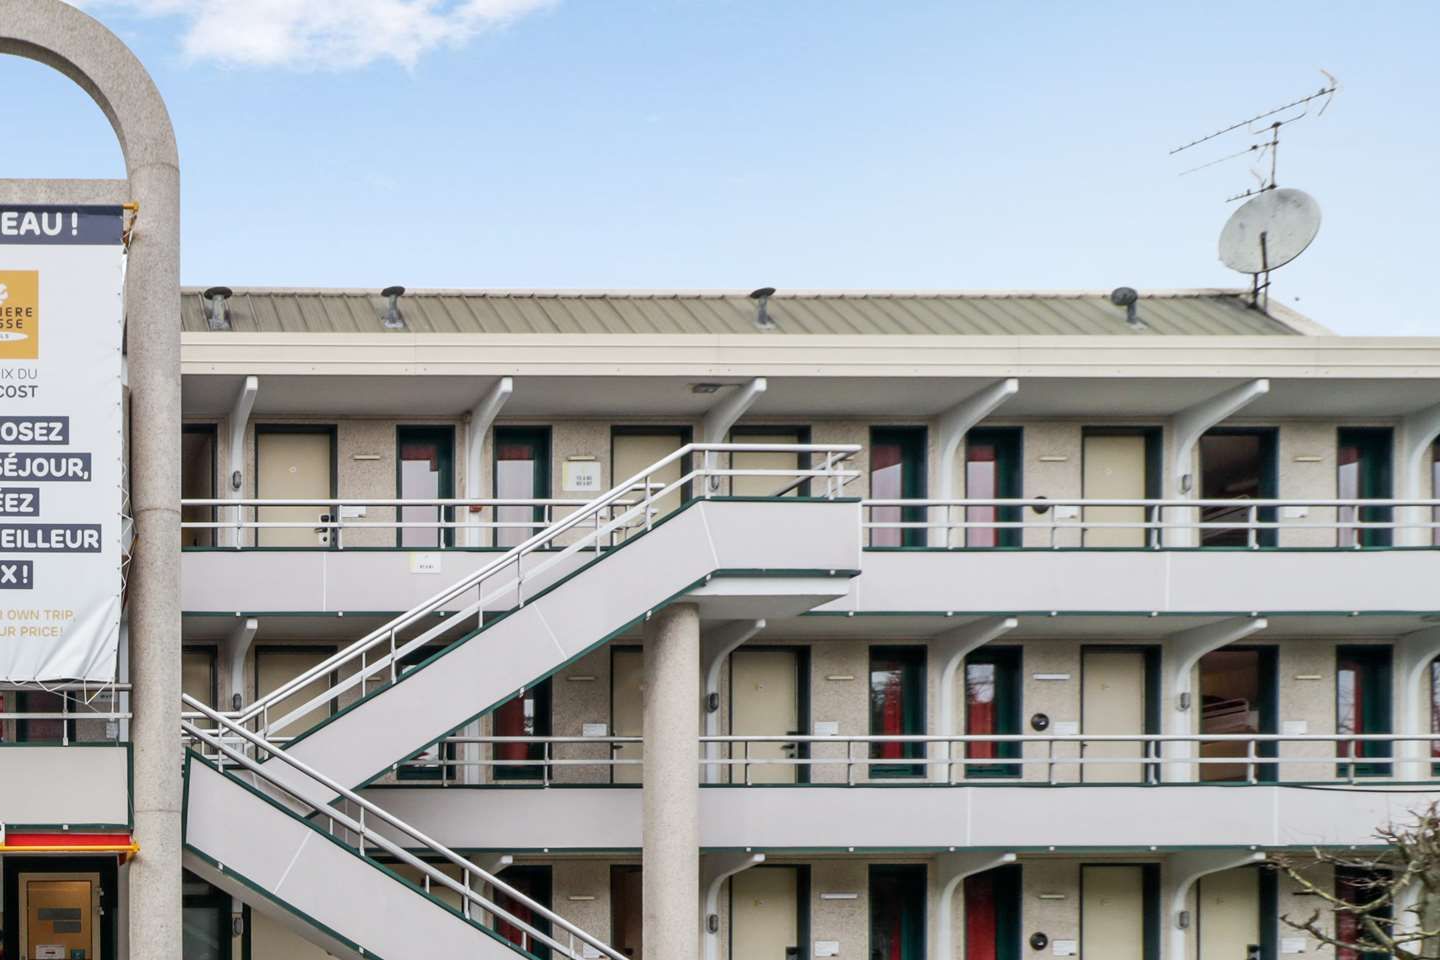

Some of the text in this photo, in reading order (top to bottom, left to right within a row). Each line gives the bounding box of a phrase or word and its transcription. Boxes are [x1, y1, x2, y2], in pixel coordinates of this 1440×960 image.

[17, 368, 38, 380] DU
[7, 609, 40, 620] OWN
[44, 609, 77, 622] TRIP,
